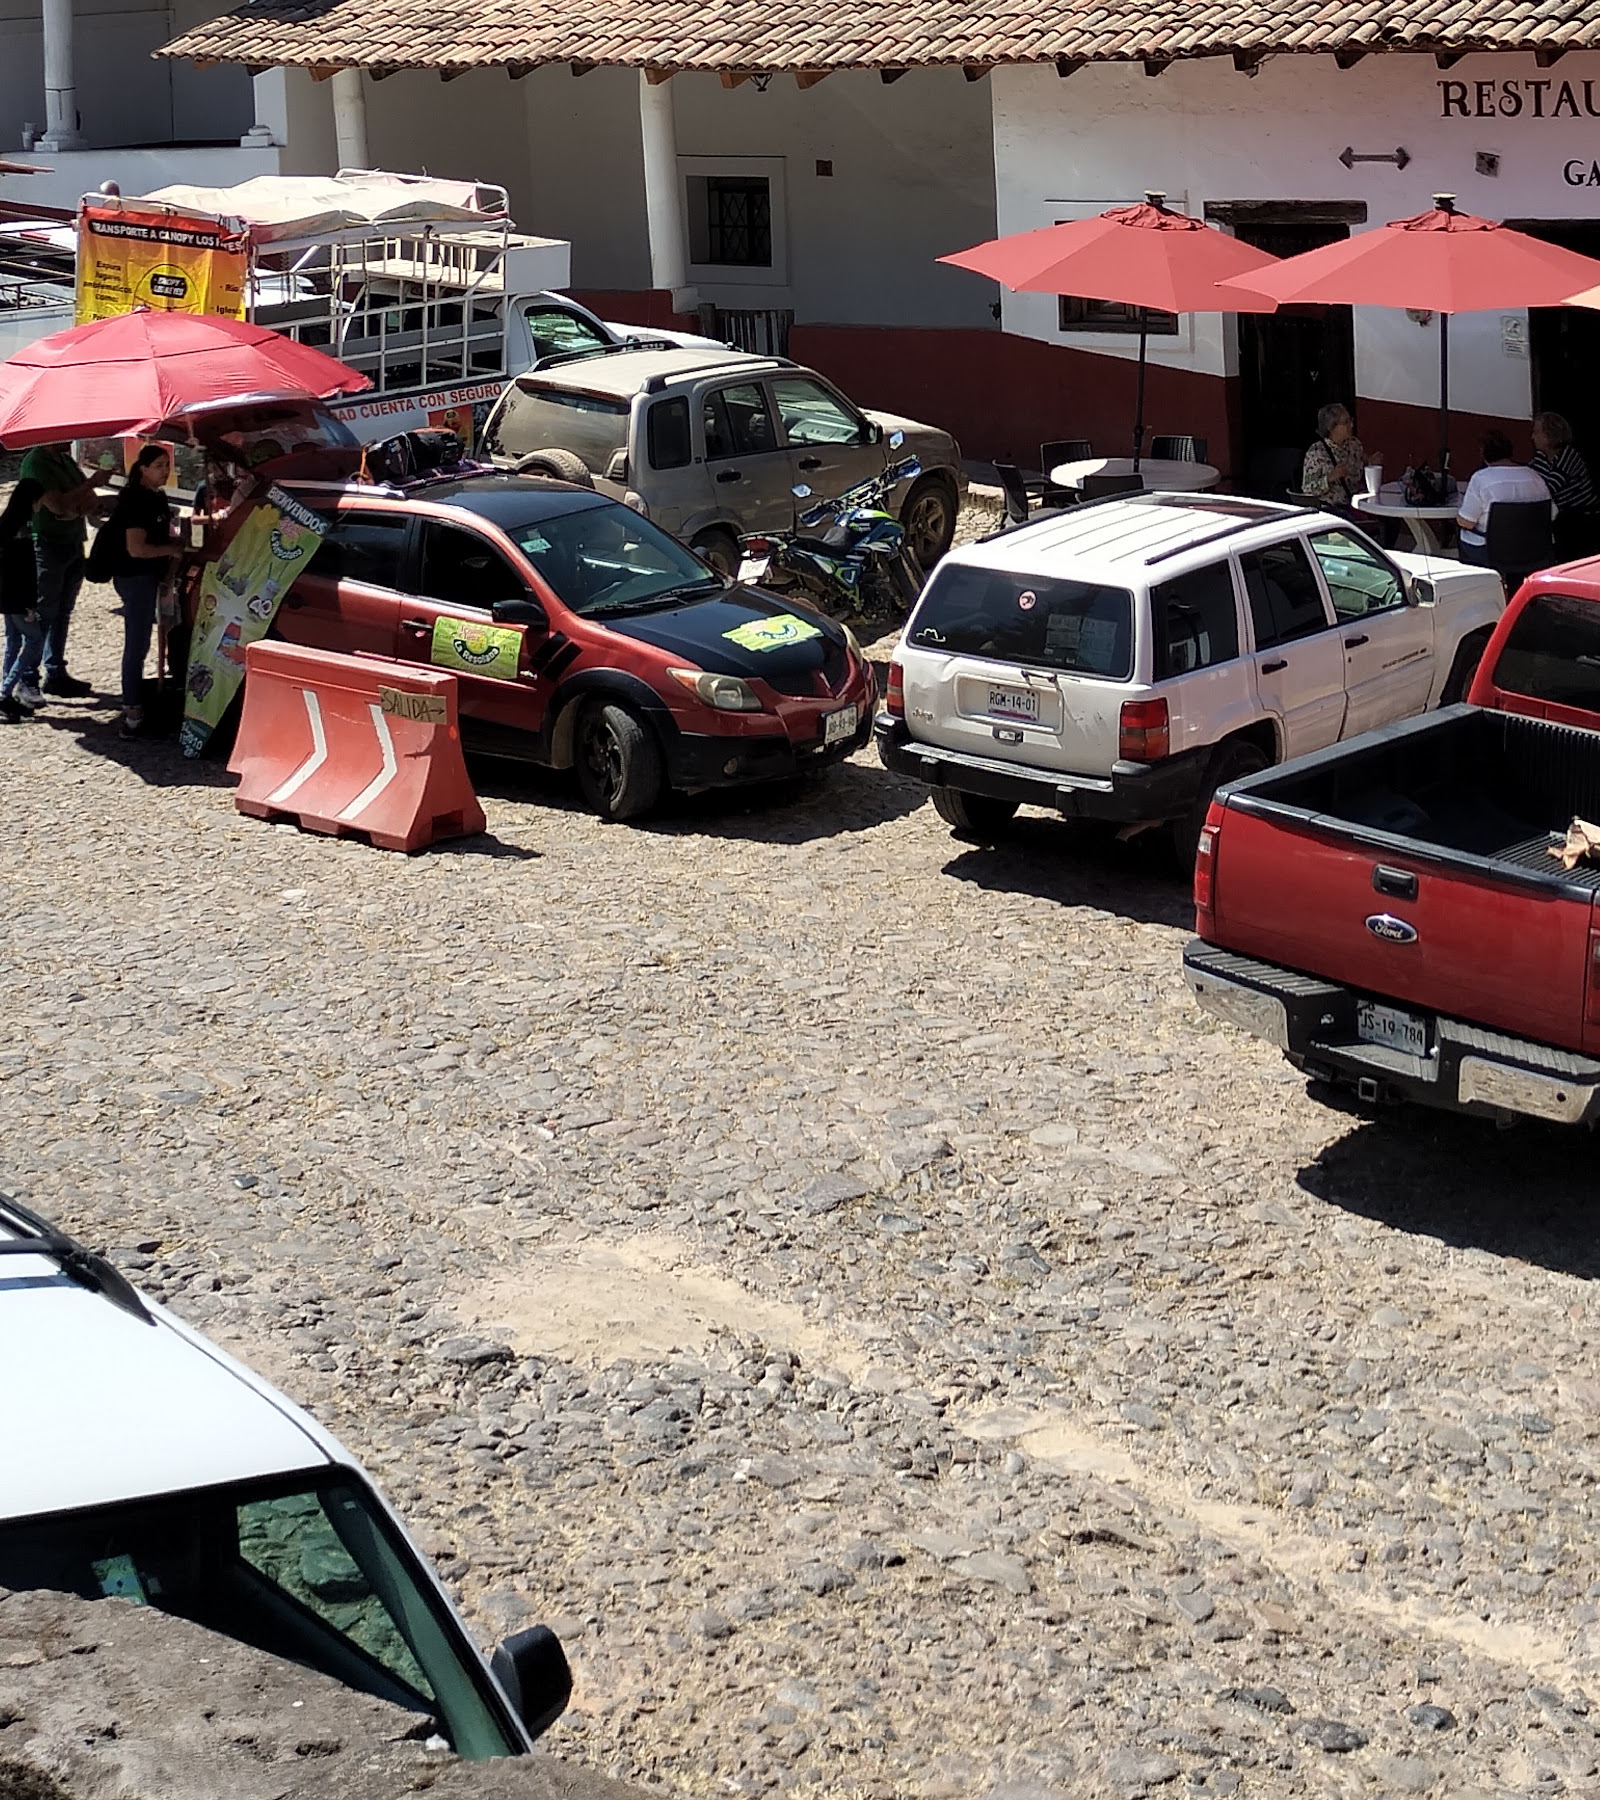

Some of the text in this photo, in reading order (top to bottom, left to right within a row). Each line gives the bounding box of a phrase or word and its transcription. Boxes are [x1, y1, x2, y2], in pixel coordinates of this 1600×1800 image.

[91, 221, 149, 239] TRANSPORTE
[150, 229, 158, 240] A
[159, 230, 196, 245] CANOPY
[196, 235, 215, 247] LOS
[360, 398, 416, 419] CUENTA
[418, 392, 447, 409] CON
[449, 383, 503, 405] SEGURO
[267, 486, 328, 535] BIENVENIDOS
[381, 689, 431, 723] SALIDA
[1374, 920, 1405, 940] Ford
